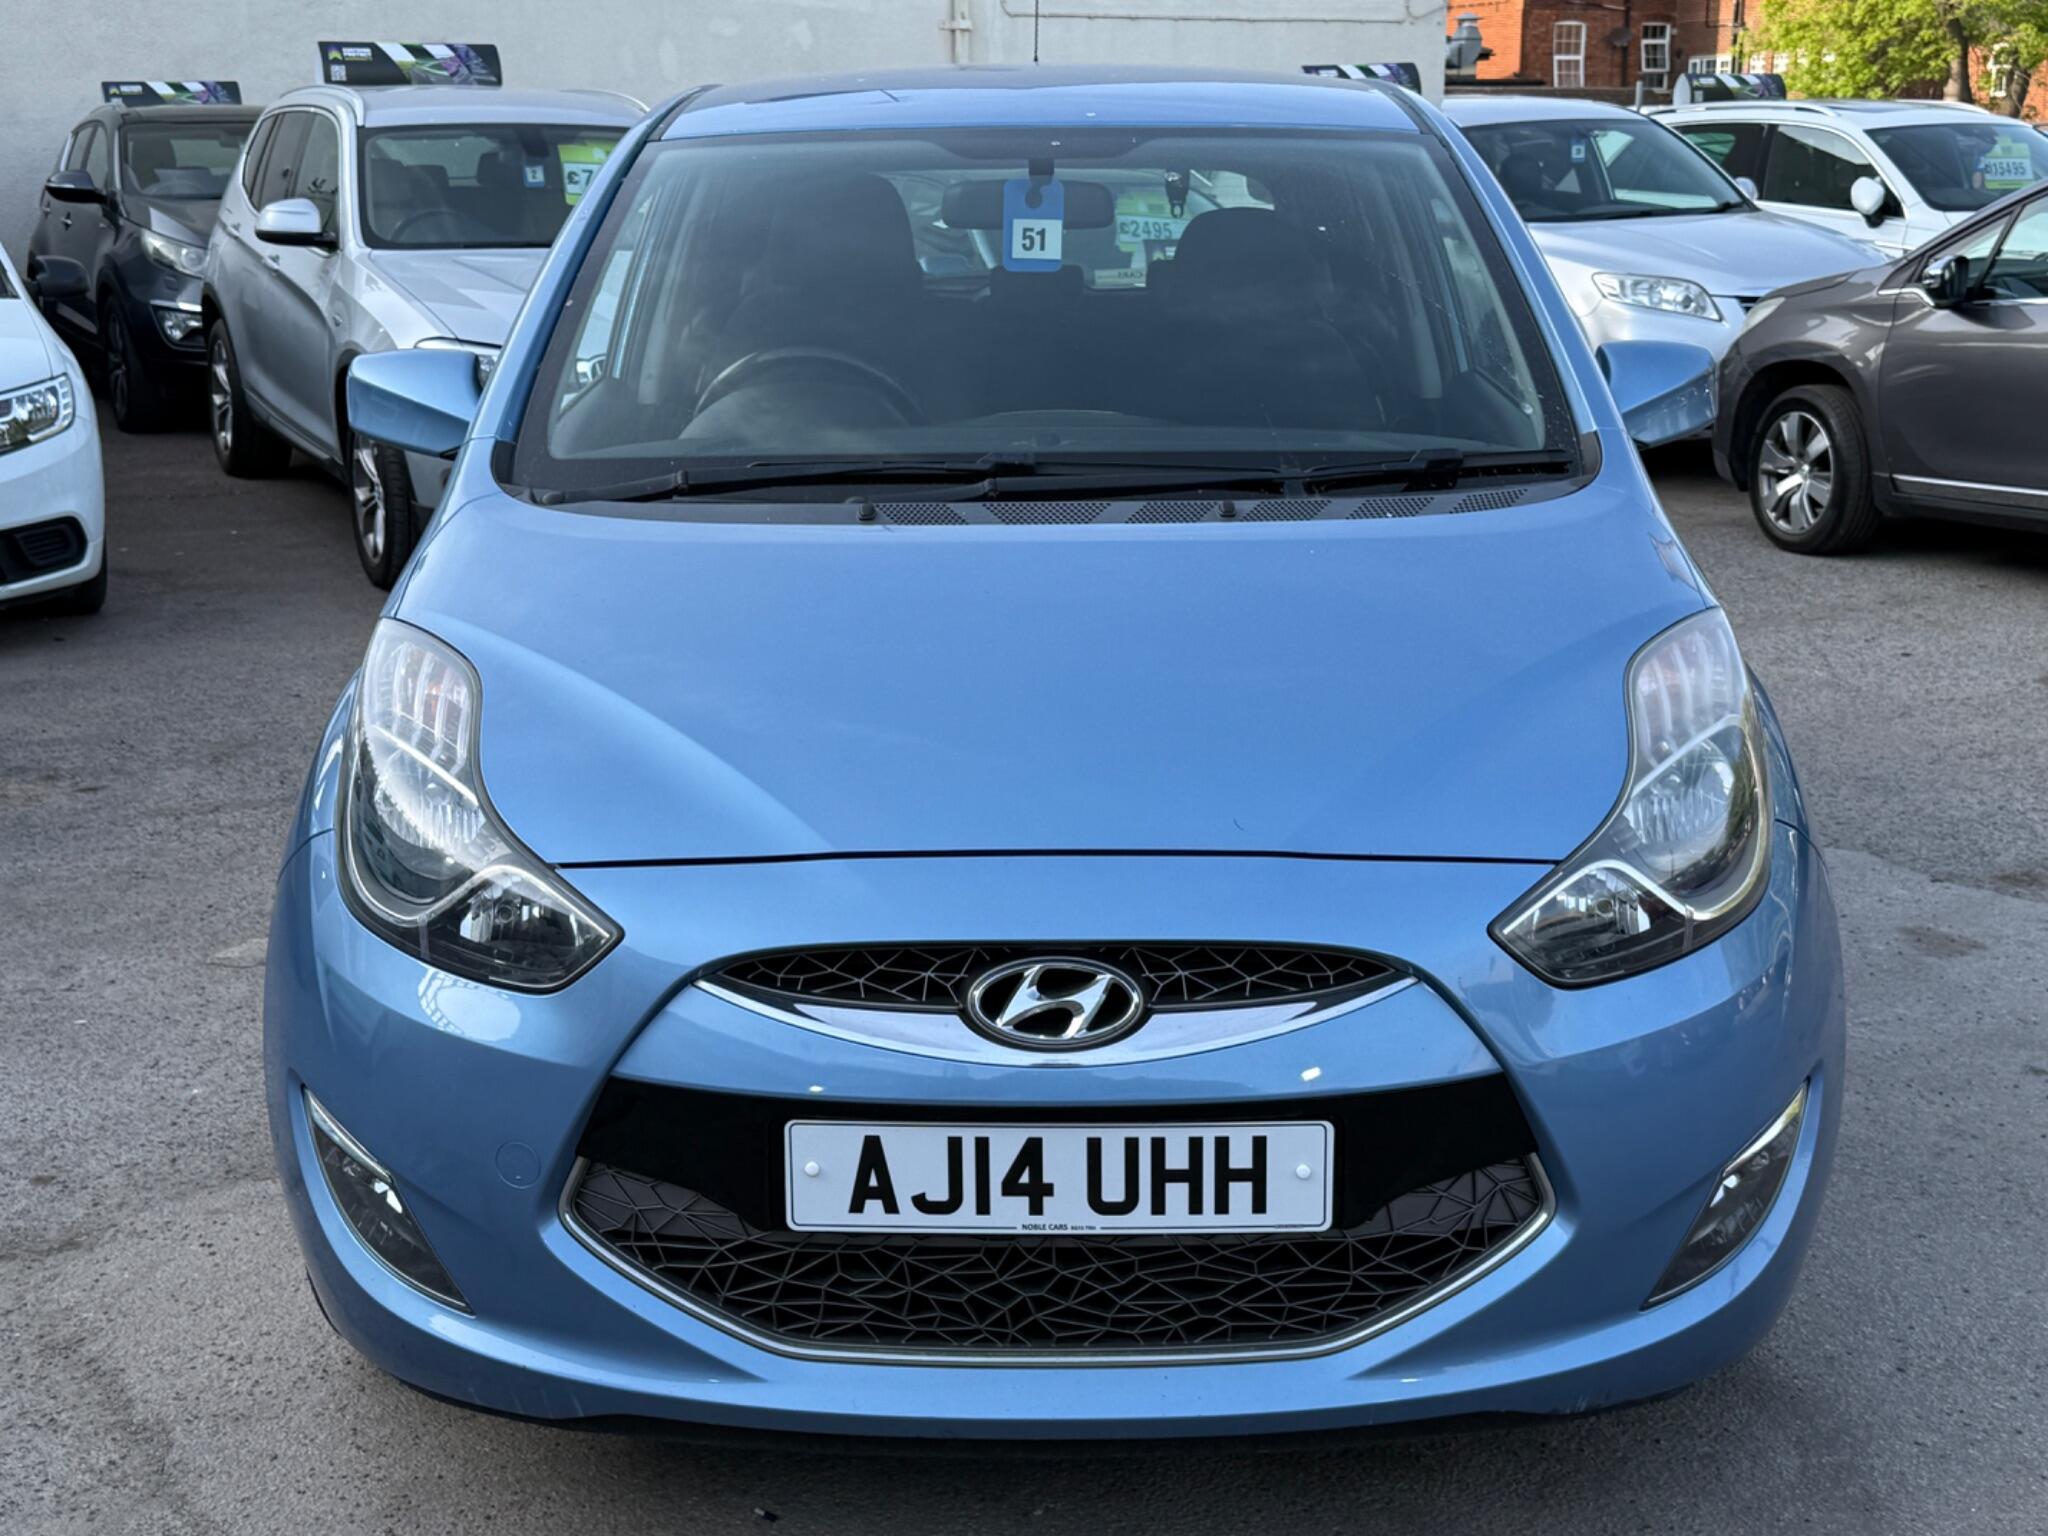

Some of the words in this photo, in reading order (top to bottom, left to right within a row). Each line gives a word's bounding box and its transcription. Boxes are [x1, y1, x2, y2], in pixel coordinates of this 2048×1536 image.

[1021, 227, 1046, 252] 51
[1119, 219, 1174, 239] £2495
[848, 1134, 1055, 1216] AJ14
[1086, 1134, 1268, 1215] UHH
[1021, 1223, 1047, 1231] NOBLE
[1048, 1223, 1069, 1231] CARS
